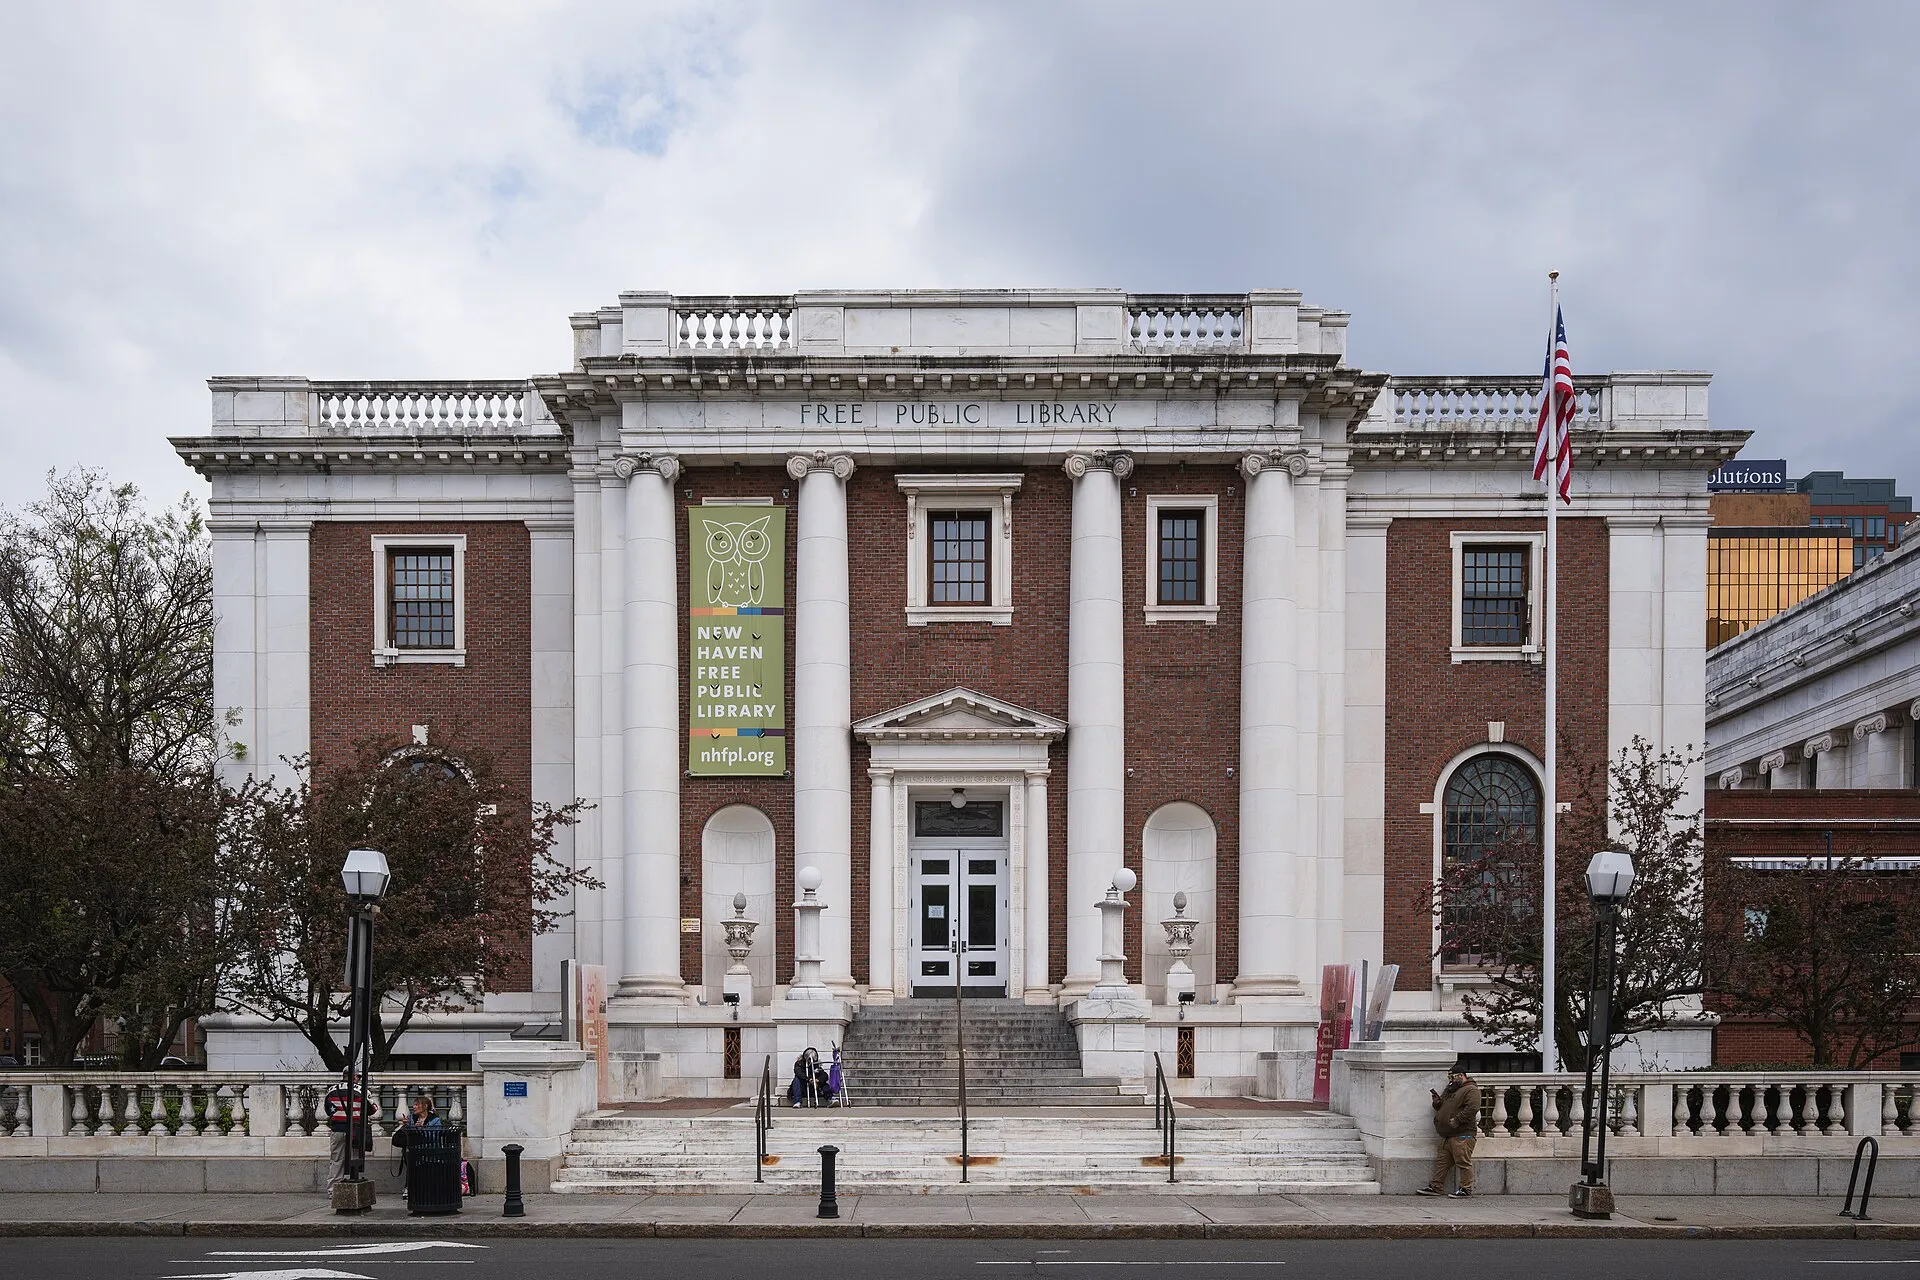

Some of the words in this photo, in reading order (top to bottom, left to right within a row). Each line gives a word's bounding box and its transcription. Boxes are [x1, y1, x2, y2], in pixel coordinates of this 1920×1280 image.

[800, 404, 863, 425] FREE
[896, 404, 981, 425] PUBLIC
[1016, 403, 1118, 425] LIBRARY
[697, 626, 742, 639] NEW
[697, 646, 763, 660] HAVEN
[697, 666, 741, 680] FREE
[697, 685, 763, 698] PUBLIC
[697, 704, 777, 718] LIBRARY
[700, 747, 774, 766] nhfpl.org
[1319, 1019, 1333, 1079] nhfpl
